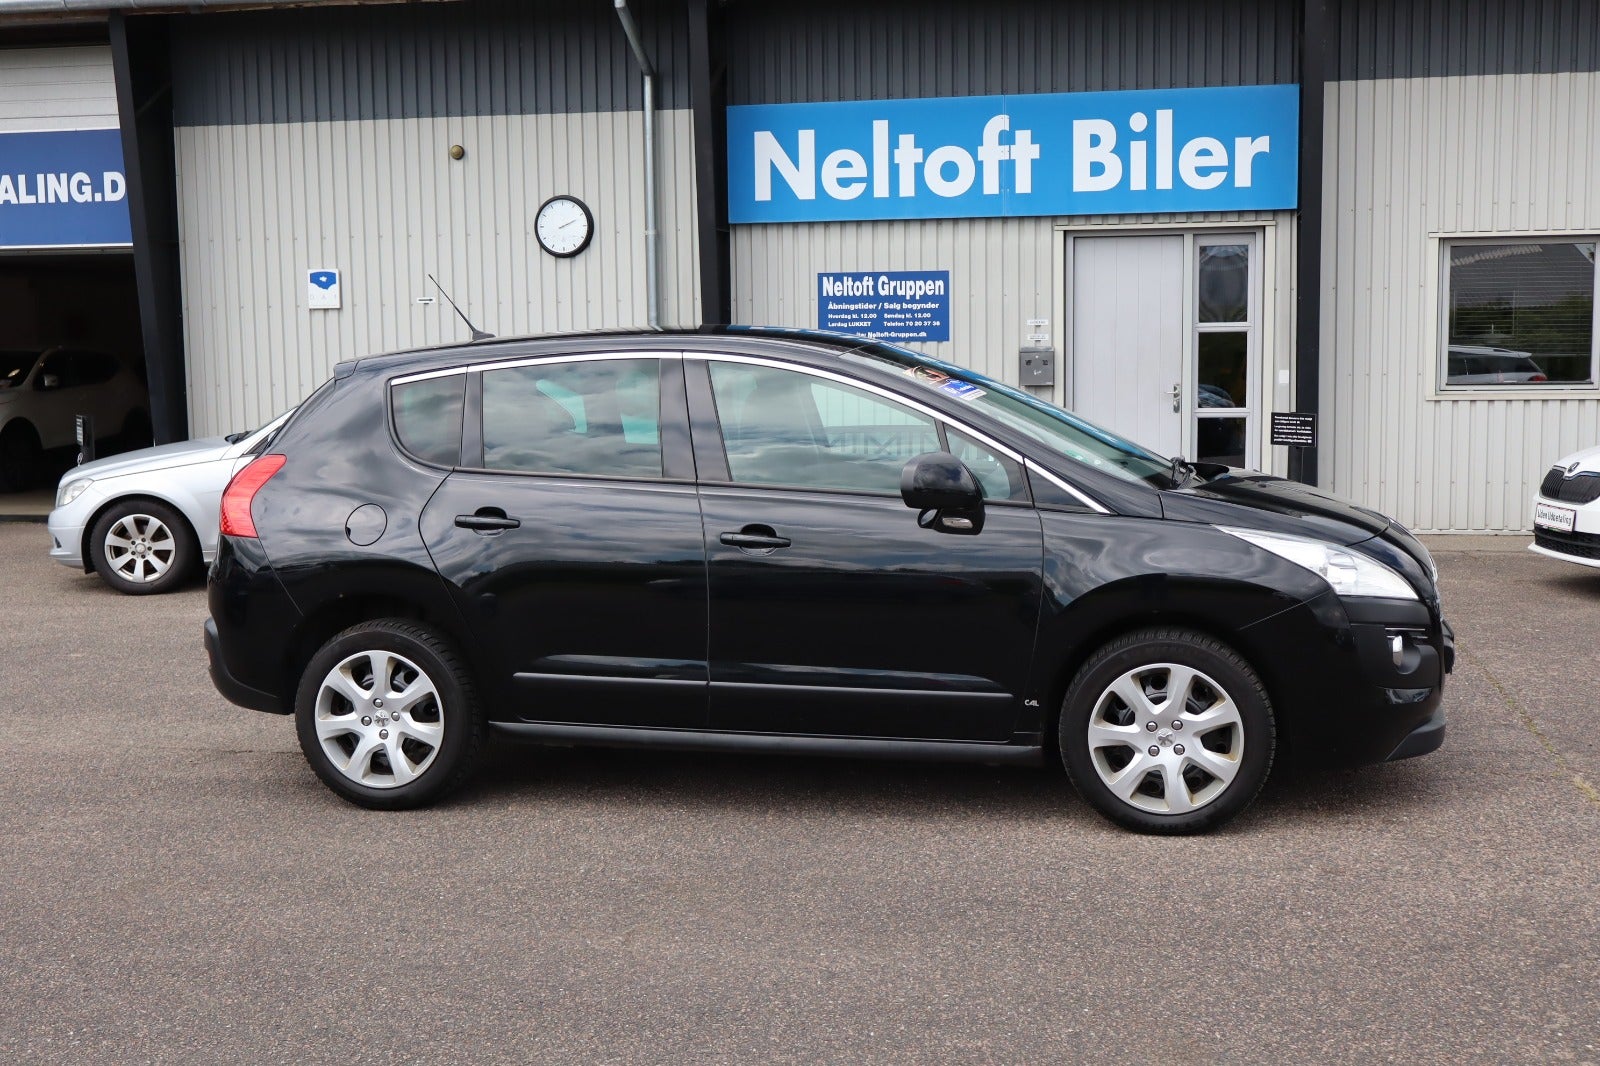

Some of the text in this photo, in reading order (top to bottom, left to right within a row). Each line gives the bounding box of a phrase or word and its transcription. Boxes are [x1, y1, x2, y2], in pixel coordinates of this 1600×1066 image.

[753, 109, 1270, 202] Neltoft Biler
[0, 171, 126, 205] ALING.D
[822, 275, 945, 300] Neltoft Gruppen
[828, 301, 877, 311] Åbningstider
[883, 302, 901, 311] Salg
[902, 302, 940, 311] begynder
